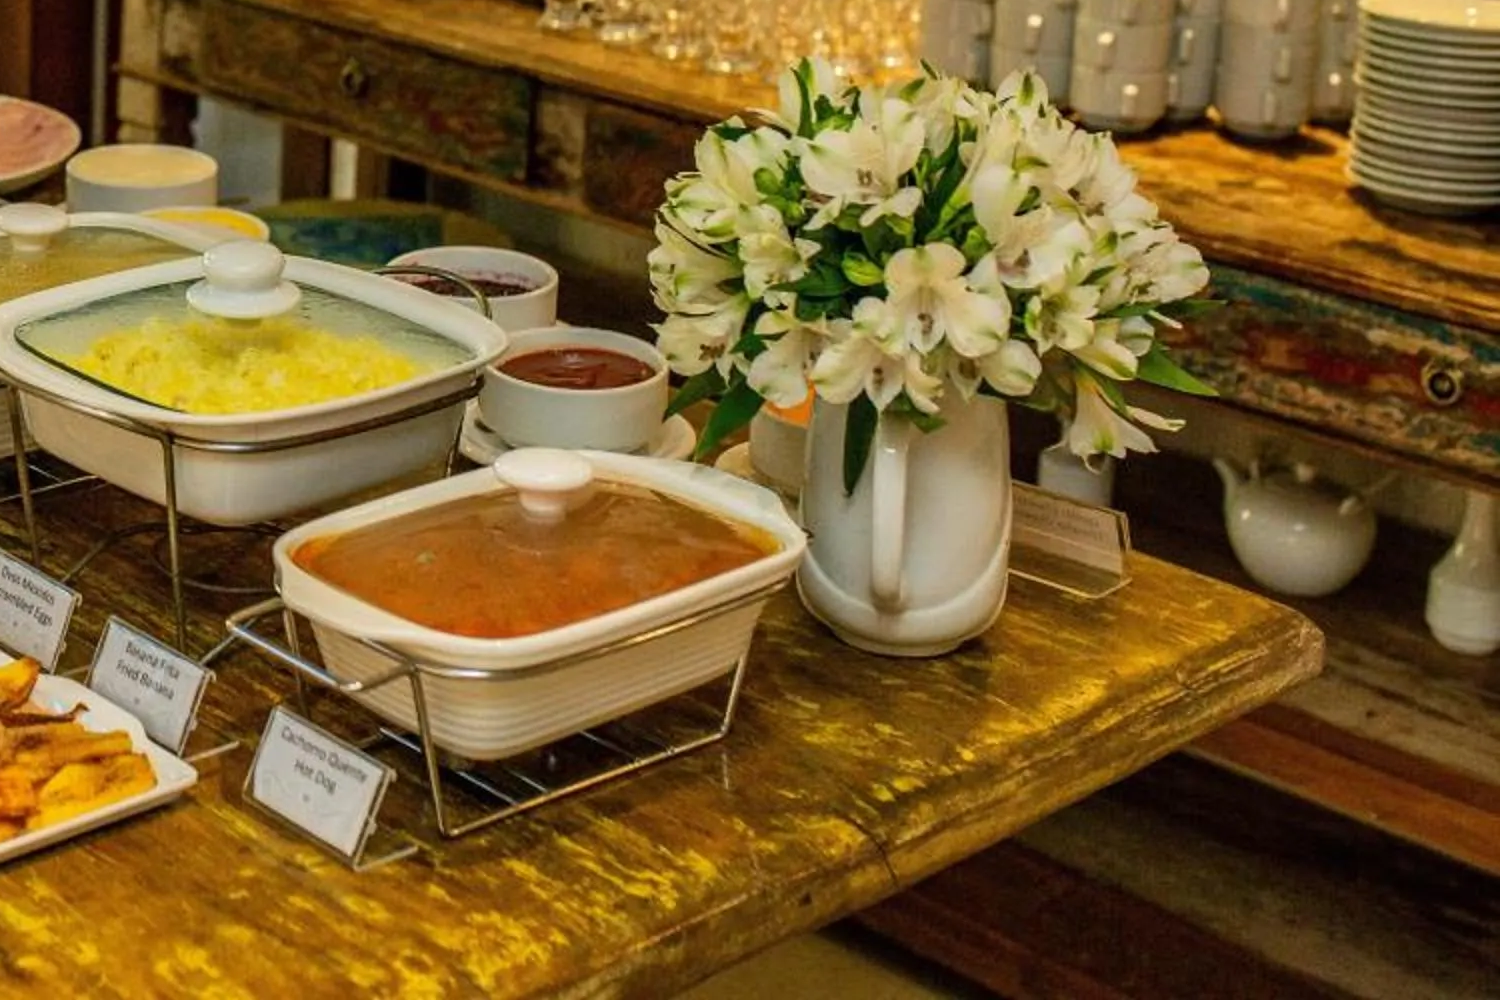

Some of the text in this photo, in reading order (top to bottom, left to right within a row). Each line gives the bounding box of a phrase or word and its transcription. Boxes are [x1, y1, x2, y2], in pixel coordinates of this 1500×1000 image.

[33, 606, 53, 627] Eggs
[116, 659, 140, 682] Fried
[281, 725, 369, 783] Cachorro Quente
[294, 759, 337, 796] Hot Dog
